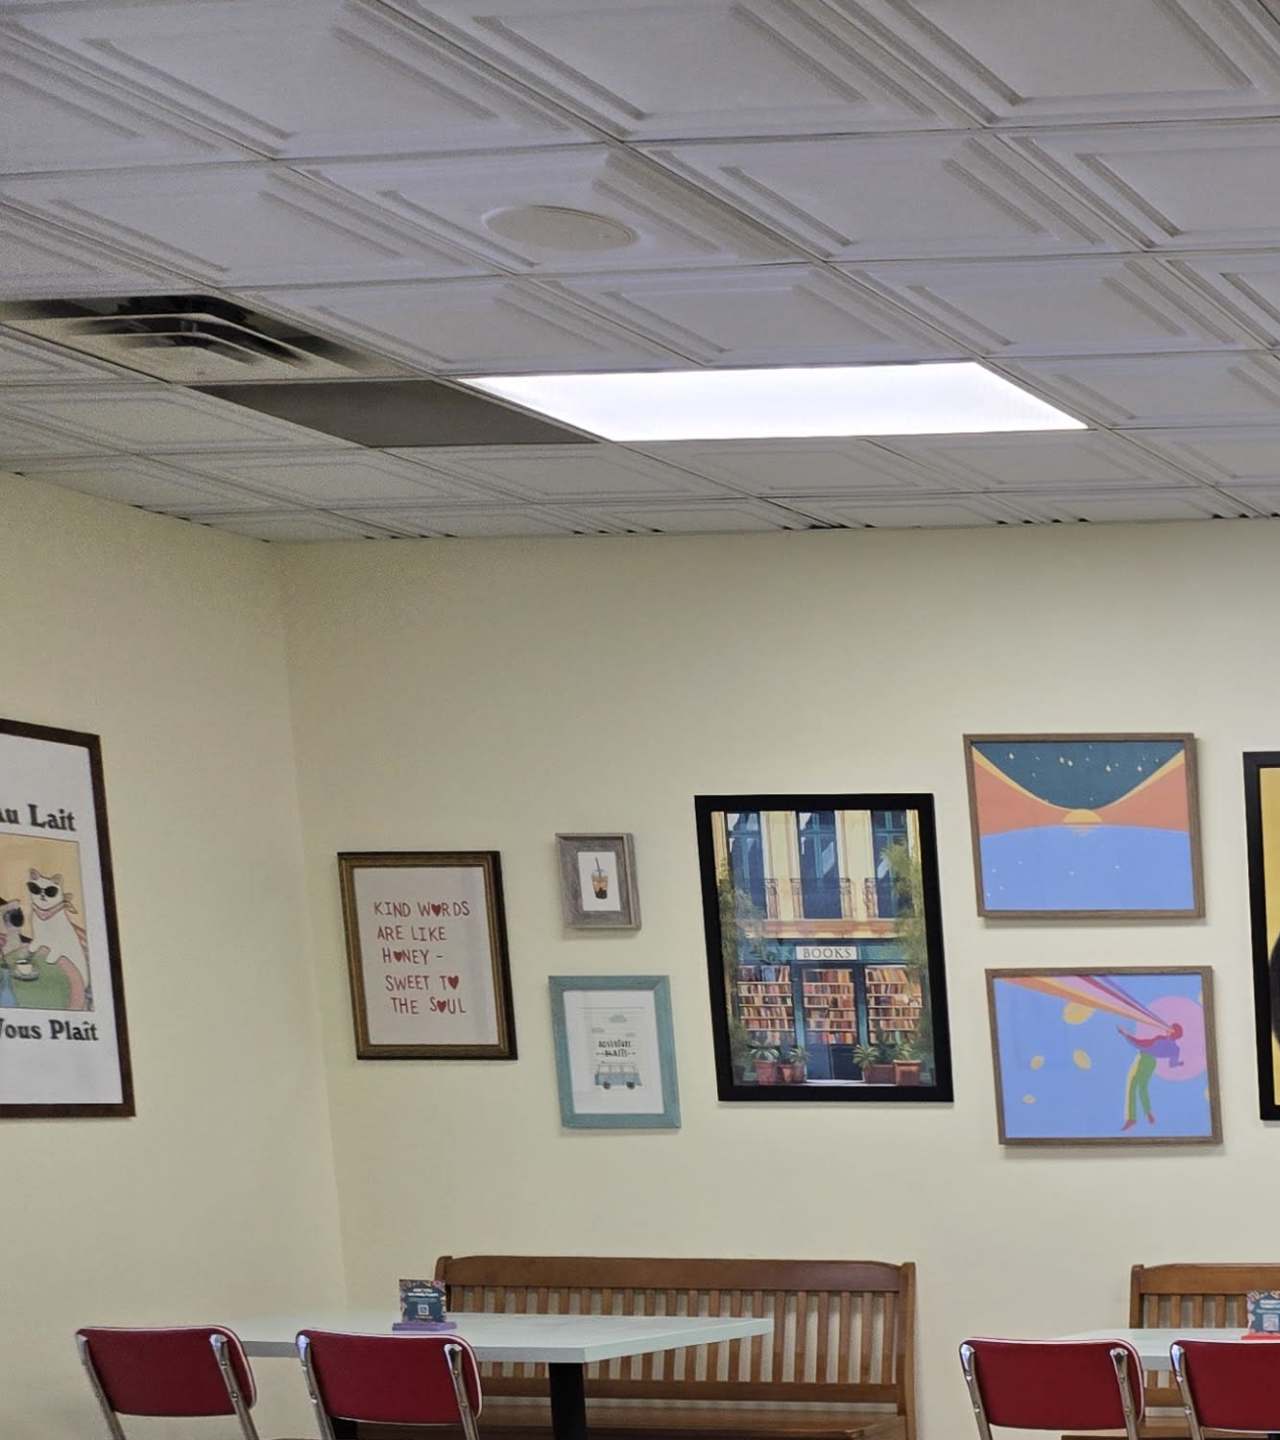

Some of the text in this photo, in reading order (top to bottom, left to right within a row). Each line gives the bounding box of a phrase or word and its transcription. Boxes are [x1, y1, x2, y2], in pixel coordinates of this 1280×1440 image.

[28, 803, 77, 832] Lait
[374, 902, 411, 917] KIND
[377, 925, 447, 941] ARE LIKE
[803, 948, 852, 959] BOOKS
[385, 975, 430, 991] SWEET
[390, 997, 419, 1014] THE
[48, 1019, 99, 1041] Plaît
